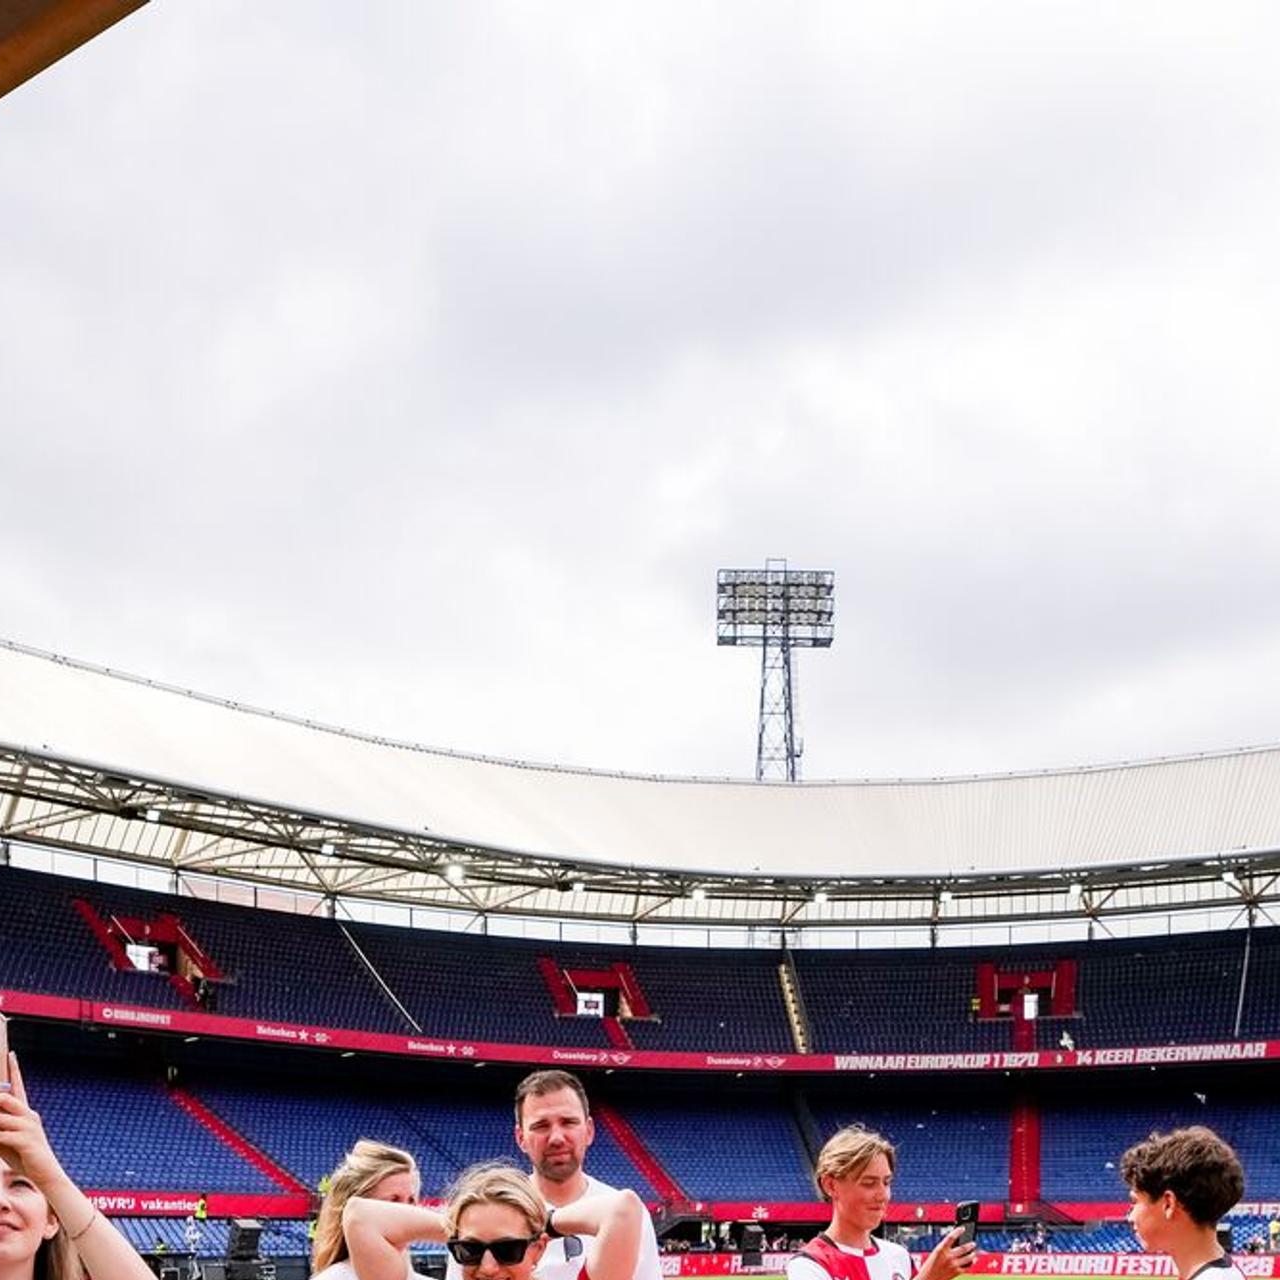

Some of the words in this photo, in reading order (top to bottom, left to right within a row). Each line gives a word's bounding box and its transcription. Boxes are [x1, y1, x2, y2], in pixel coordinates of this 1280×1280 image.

[834, 1055, 906, 1070] WINNAAR
[1001, 1254, 1116, 1275] FEYENOORD
[1116, 1255, 1179, 1276] FESTI
